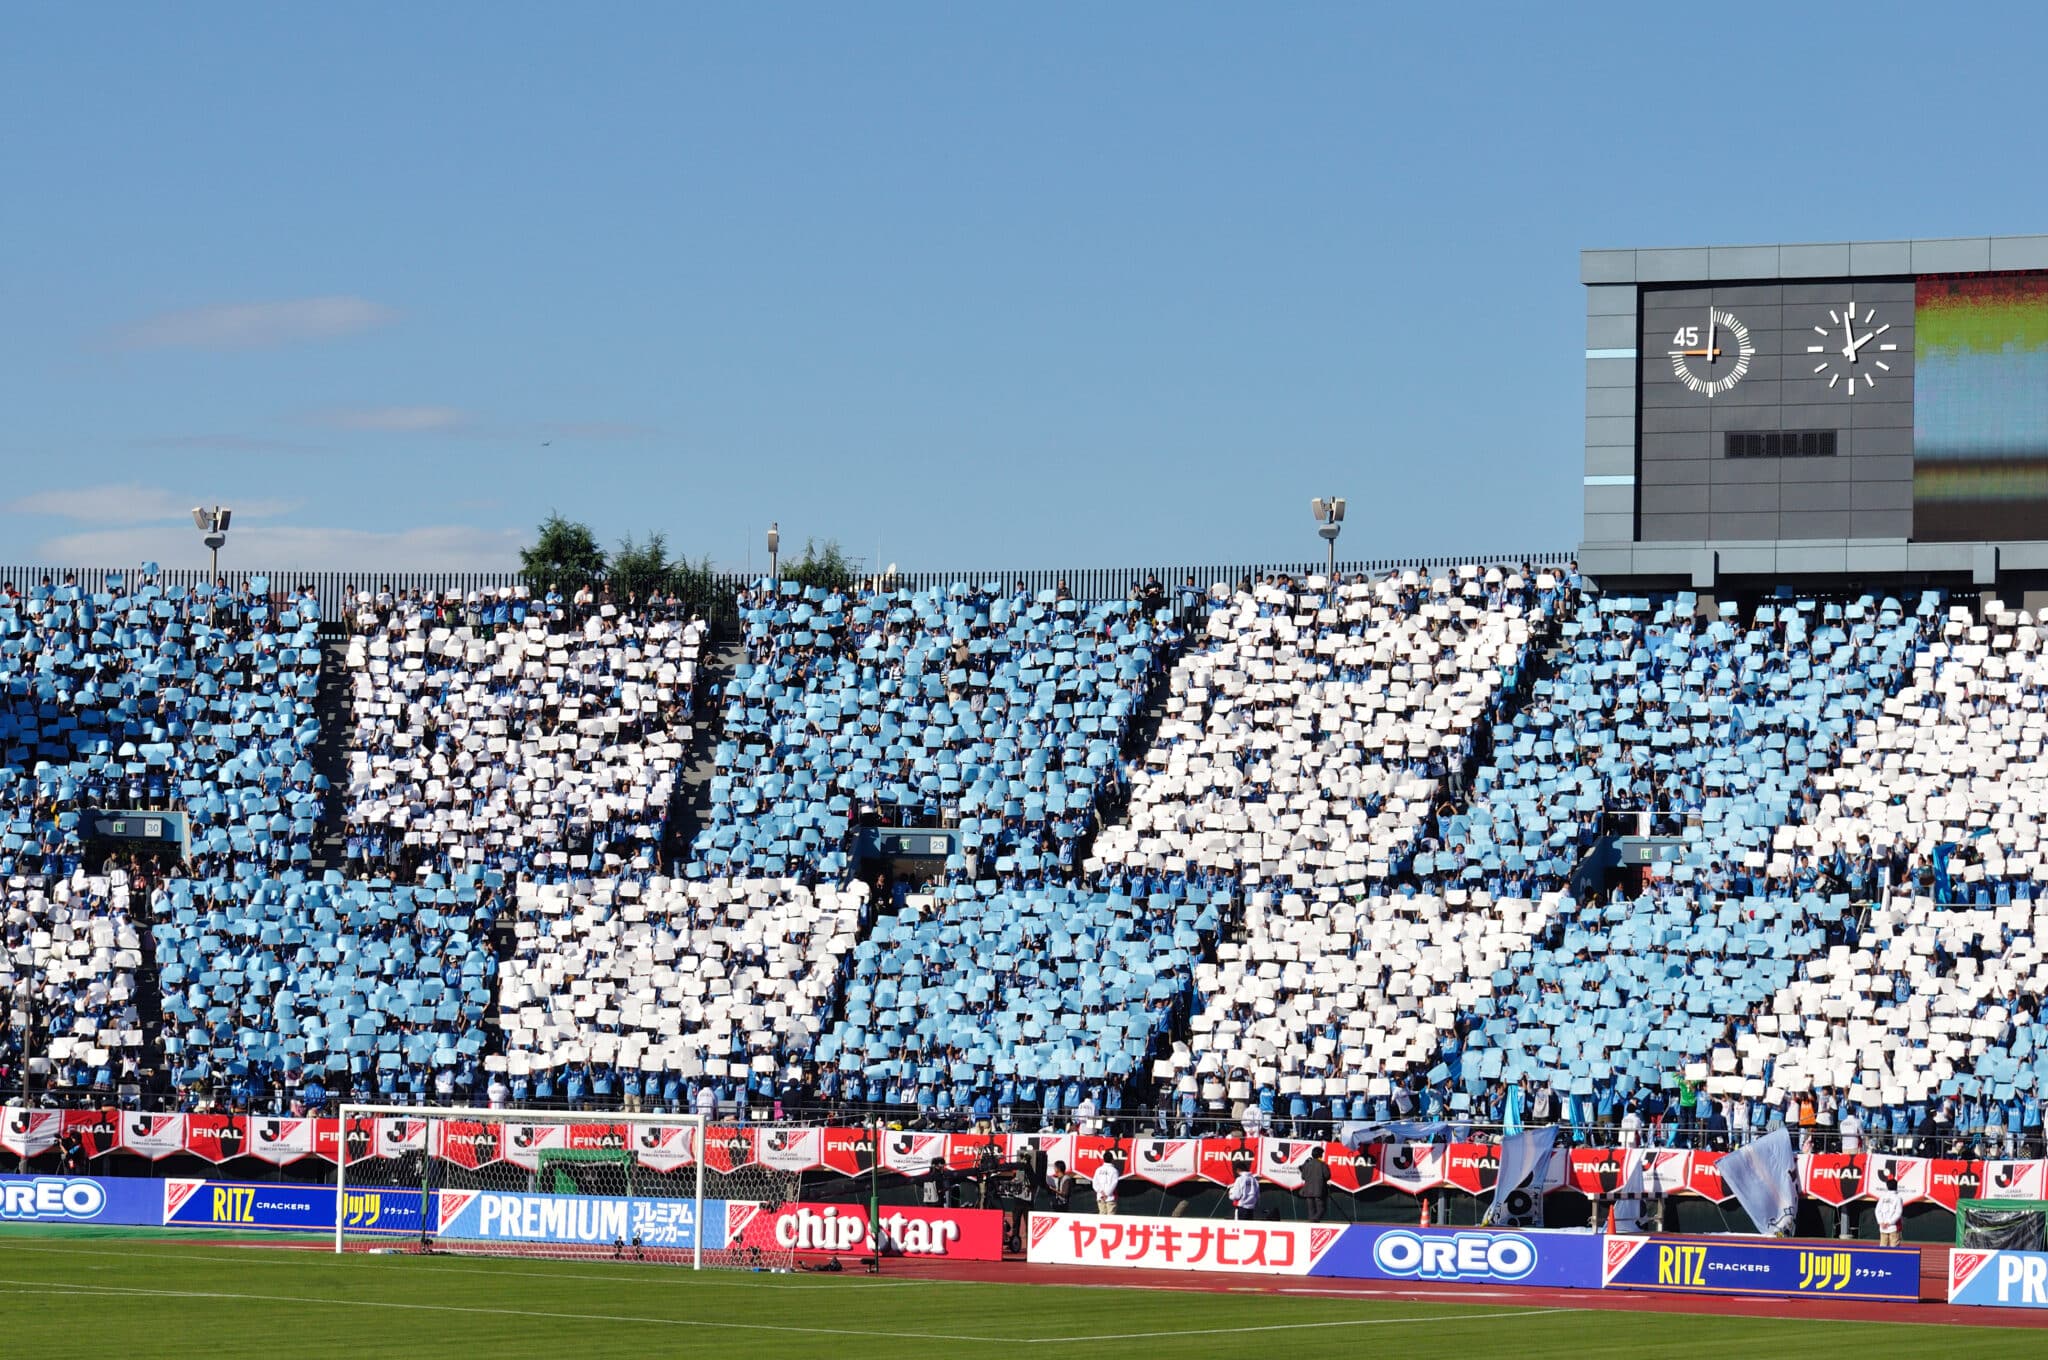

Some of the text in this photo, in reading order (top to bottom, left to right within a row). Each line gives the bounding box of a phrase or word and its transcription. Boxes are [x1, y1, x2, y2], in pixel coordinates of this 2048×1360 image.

[1673, 326, 1699, 347] 45
[146, 823, 159, 833] 30
[67, 1123, 115, 1134] FINAL
[192, 1127, 243, 1139] FINAL
[447, 1133, 497, 1145] FINAL
[573, 1136, 624, 1146] FINAL
[1204, 1151, 1255, 1162] FINAL
[1327, 1155, 1377, 1167] FINAL
[1451, 1157, 1500, 1169] FINAL
[1573, 1162, 1620, 1174] FINAL
[1812, 1168, 1862, 1180] FINAL
[1933, 1173, 1981, 1186] FINAL
[0, 1182, 102, 1215] REO
[212, 1187, 255, 1223] RITZ
[256, 1201, 311, 1211] CRACKERS
[383, 1206, 417, 1215] クラッカー
[479, 1194, 629, 1242] PREMIUM
[632, 1201, 694, 1225] プレミアム
[632, 1222, 690, 1243] クラッカー
[1069, 1220, 1295, 1267] ヤマザキナビスコ
[1378, 1235, 1532, 1275] OREO
[1658, 1245, 1708, 1286] RITZ
[1708, 1262, 1770, 1273] CRACKERS
[1799, 1251, 1892, 1291] リッツ クラッカー
